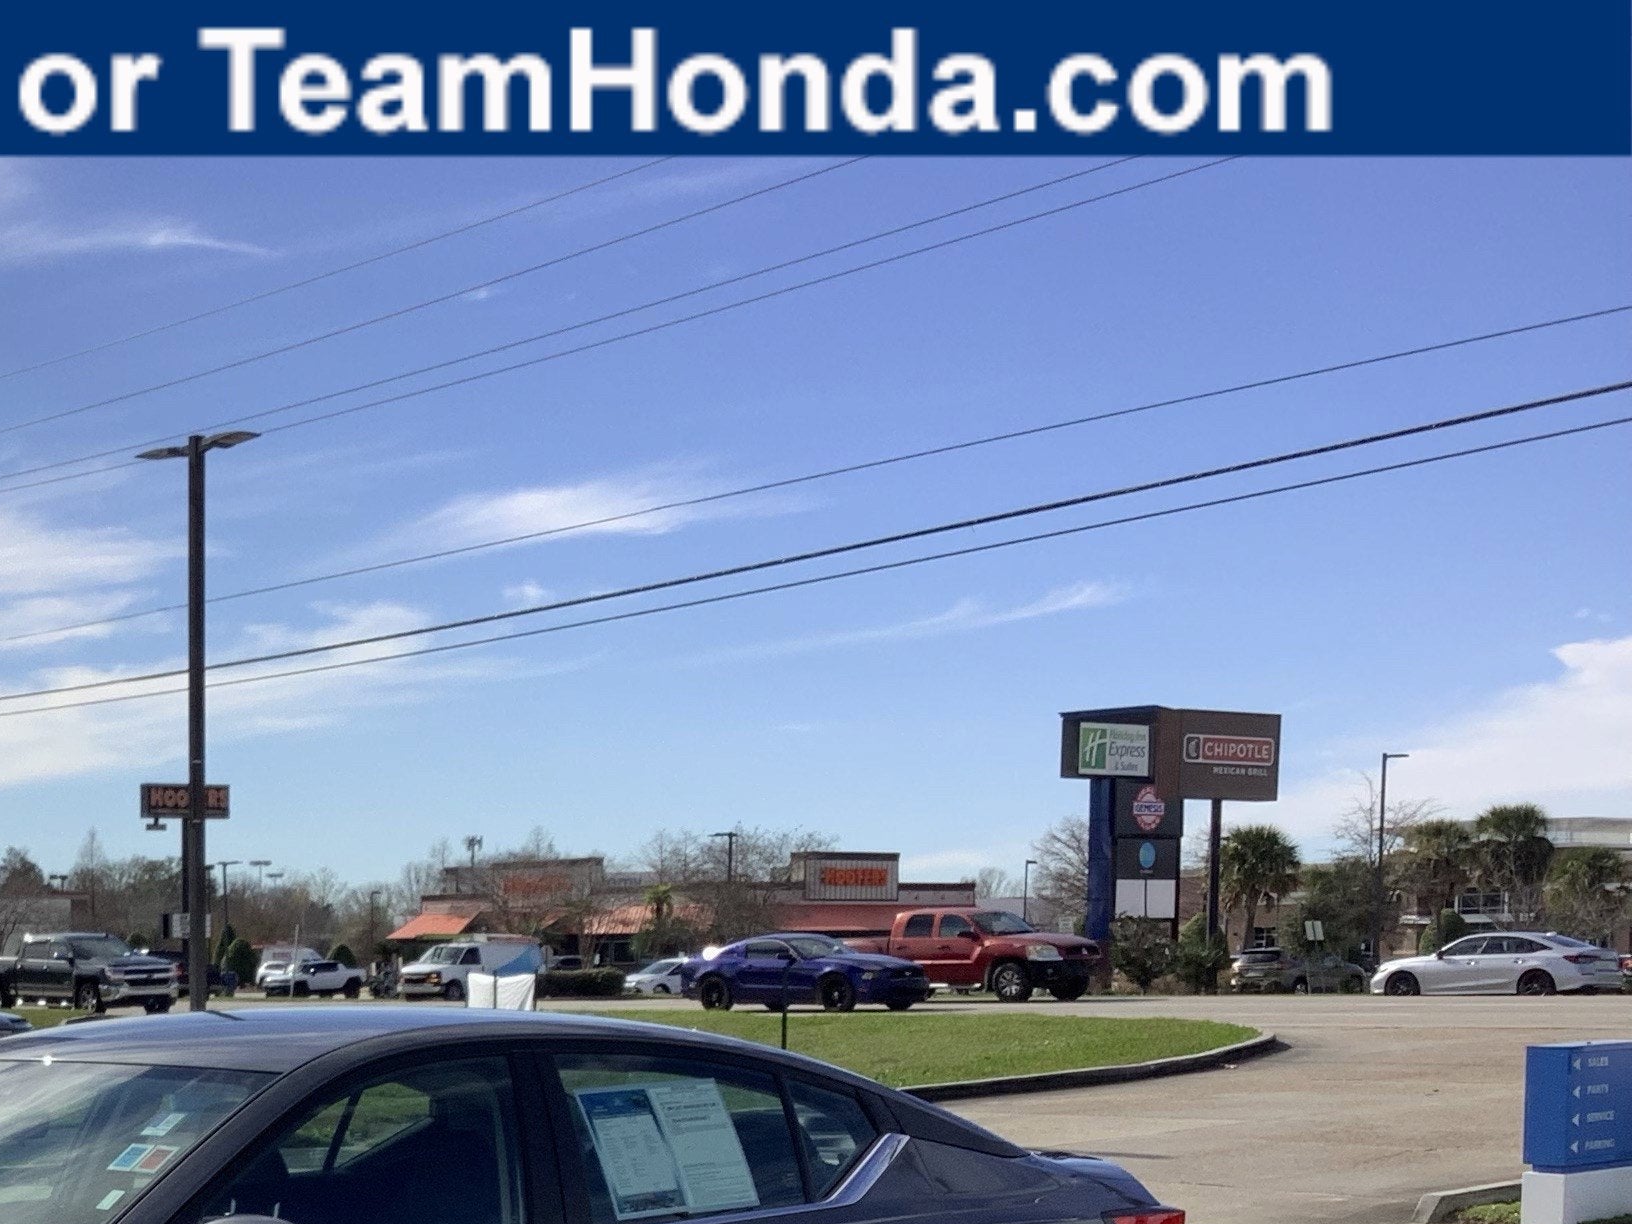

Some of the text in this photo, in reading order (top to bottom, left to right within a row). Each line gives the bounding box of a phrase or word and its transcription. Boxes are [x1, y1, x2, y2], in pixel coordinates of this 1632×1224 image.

[1108, 741, 1146, 759] Express
[1204, 741, 1270, 759] CHIPOTLE
[1212, 766, 1268, 777] MEXICAN GRILL
[149, 787, 228, 809] HOORS
[1586, 1110, 1616, 1123] SERVICE
